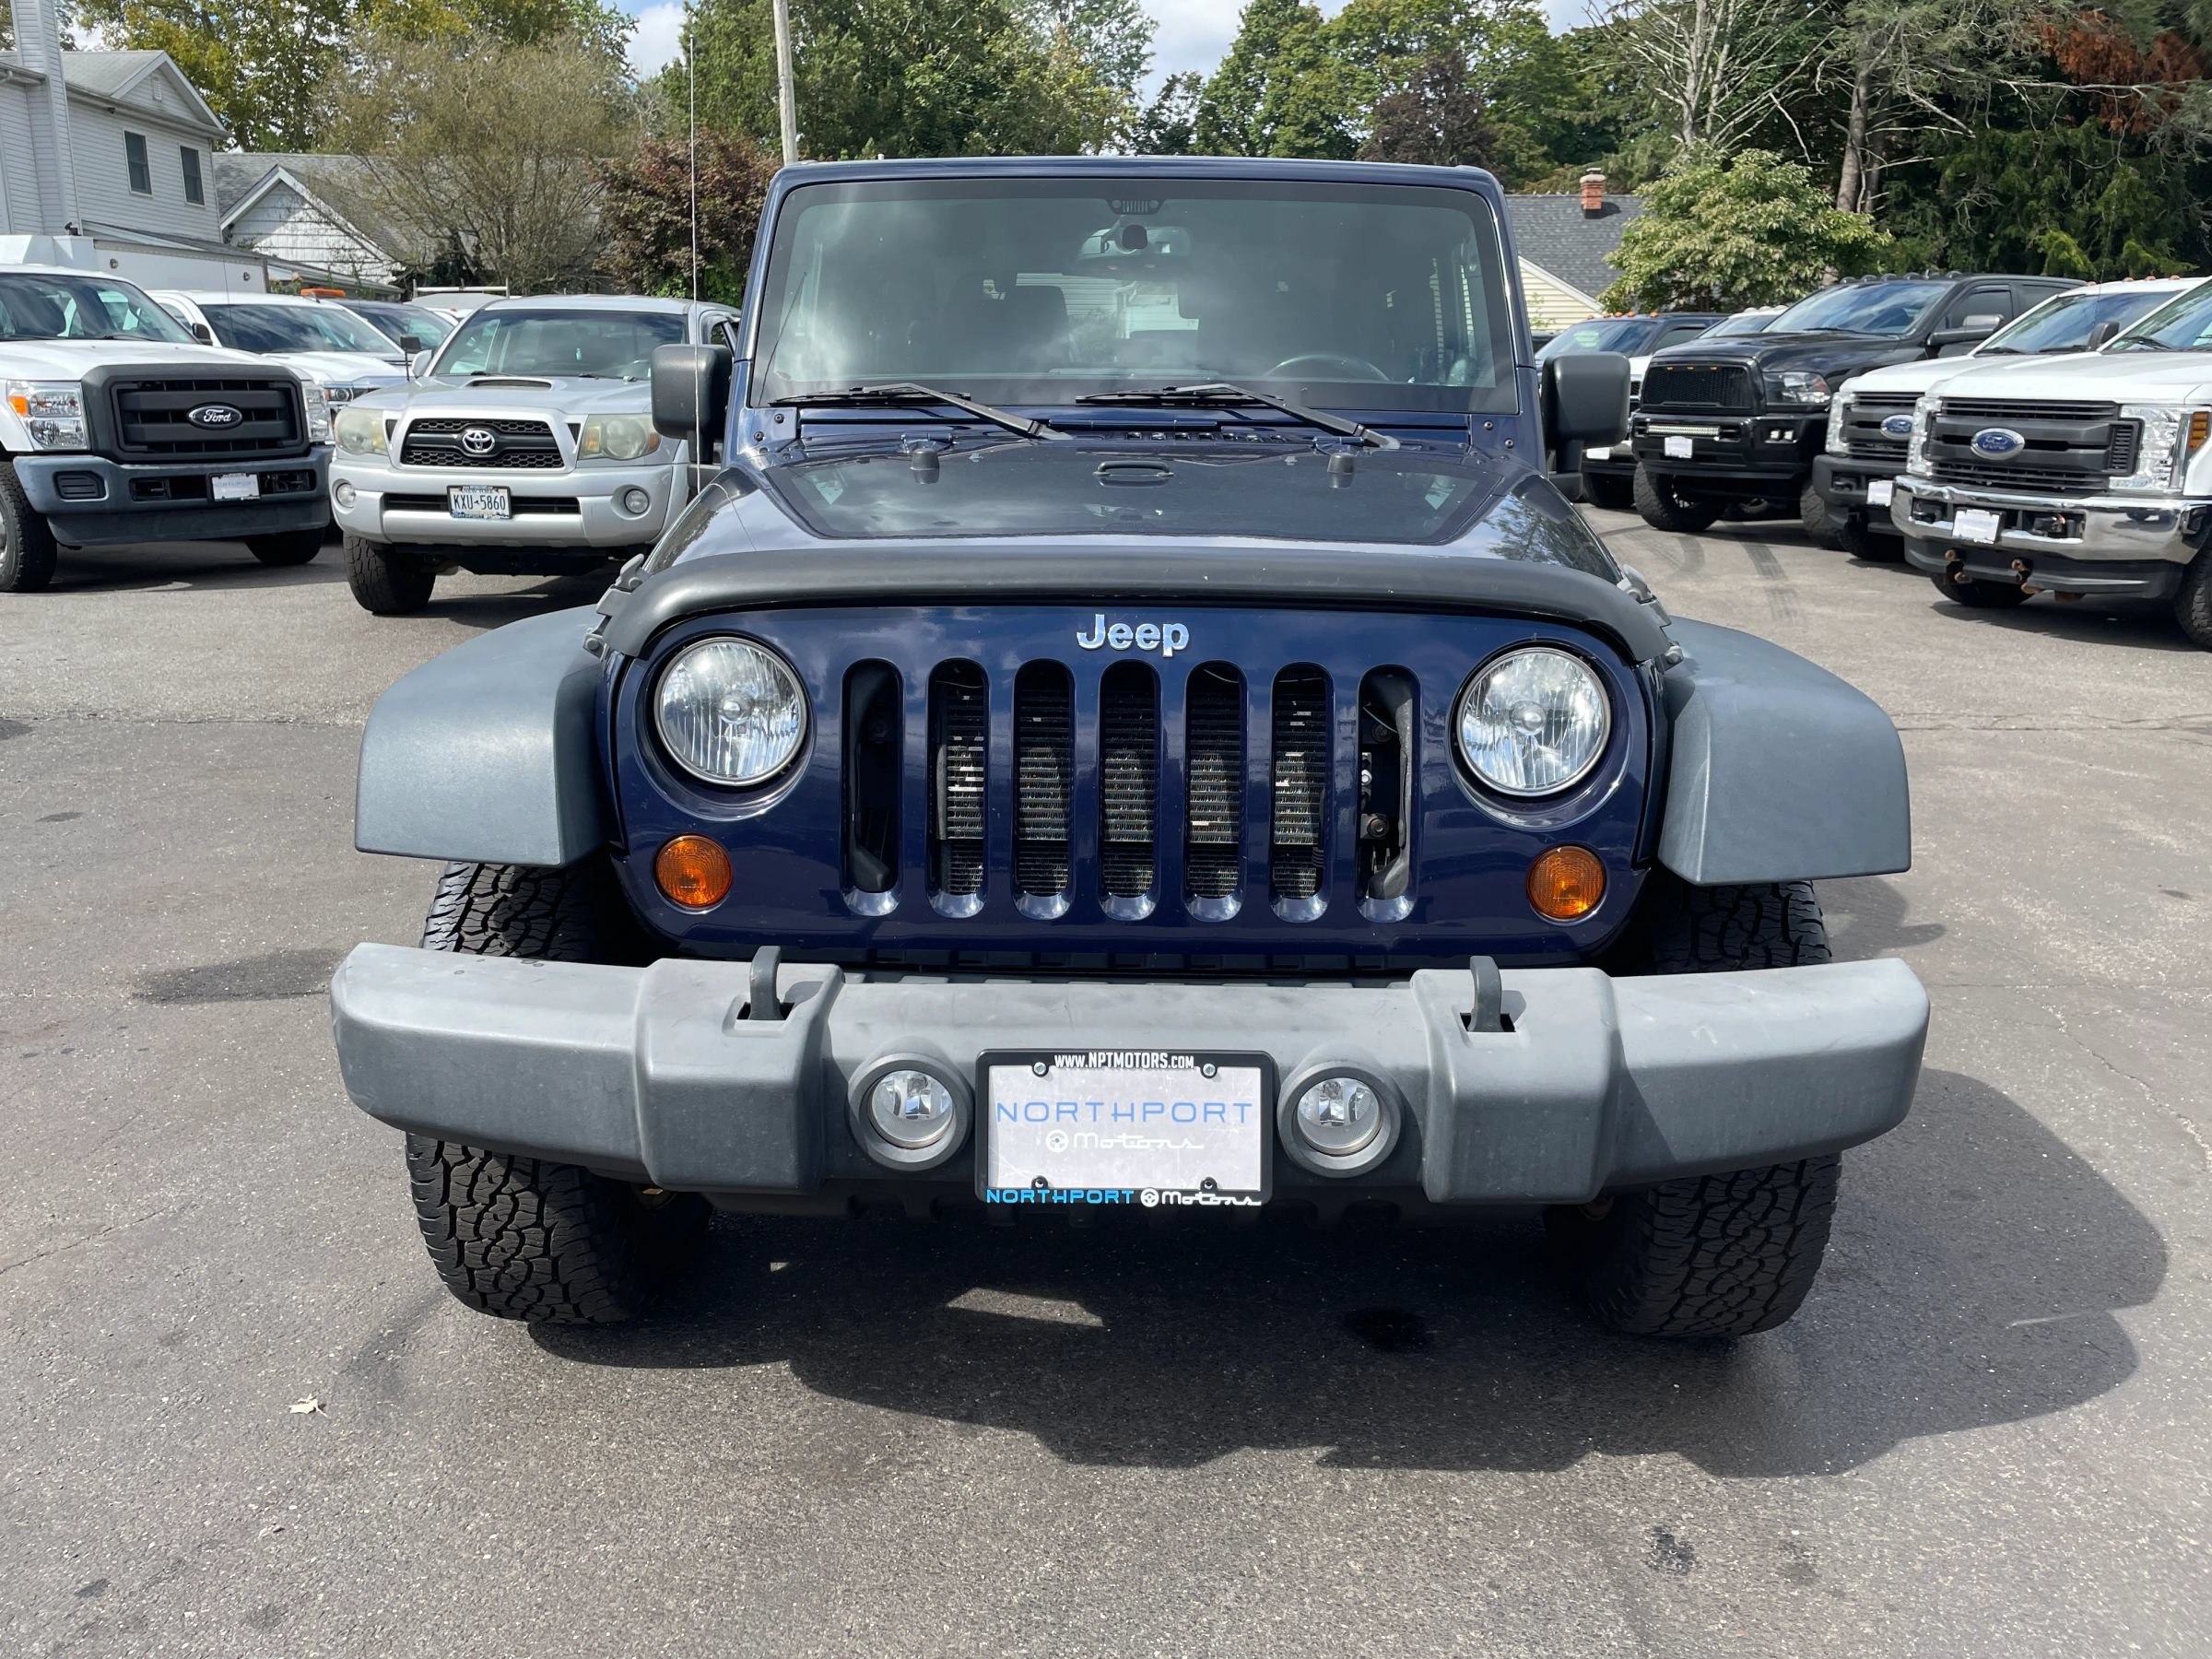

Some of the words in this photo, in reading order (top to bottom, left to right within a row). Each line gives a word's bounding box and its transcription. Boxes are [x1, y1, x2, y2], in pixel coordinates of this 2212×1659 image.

[204, 409, 231, 422] Ford
[1077, 614, 1190, 657] Jeep
[1054, 1052, 1194, 1069] WWW.NPTMOTORS.COM
[996, 1101, 1253, 1124] NORTHPORT
[986, 1189, 1135, 1204] NORTHPORT
